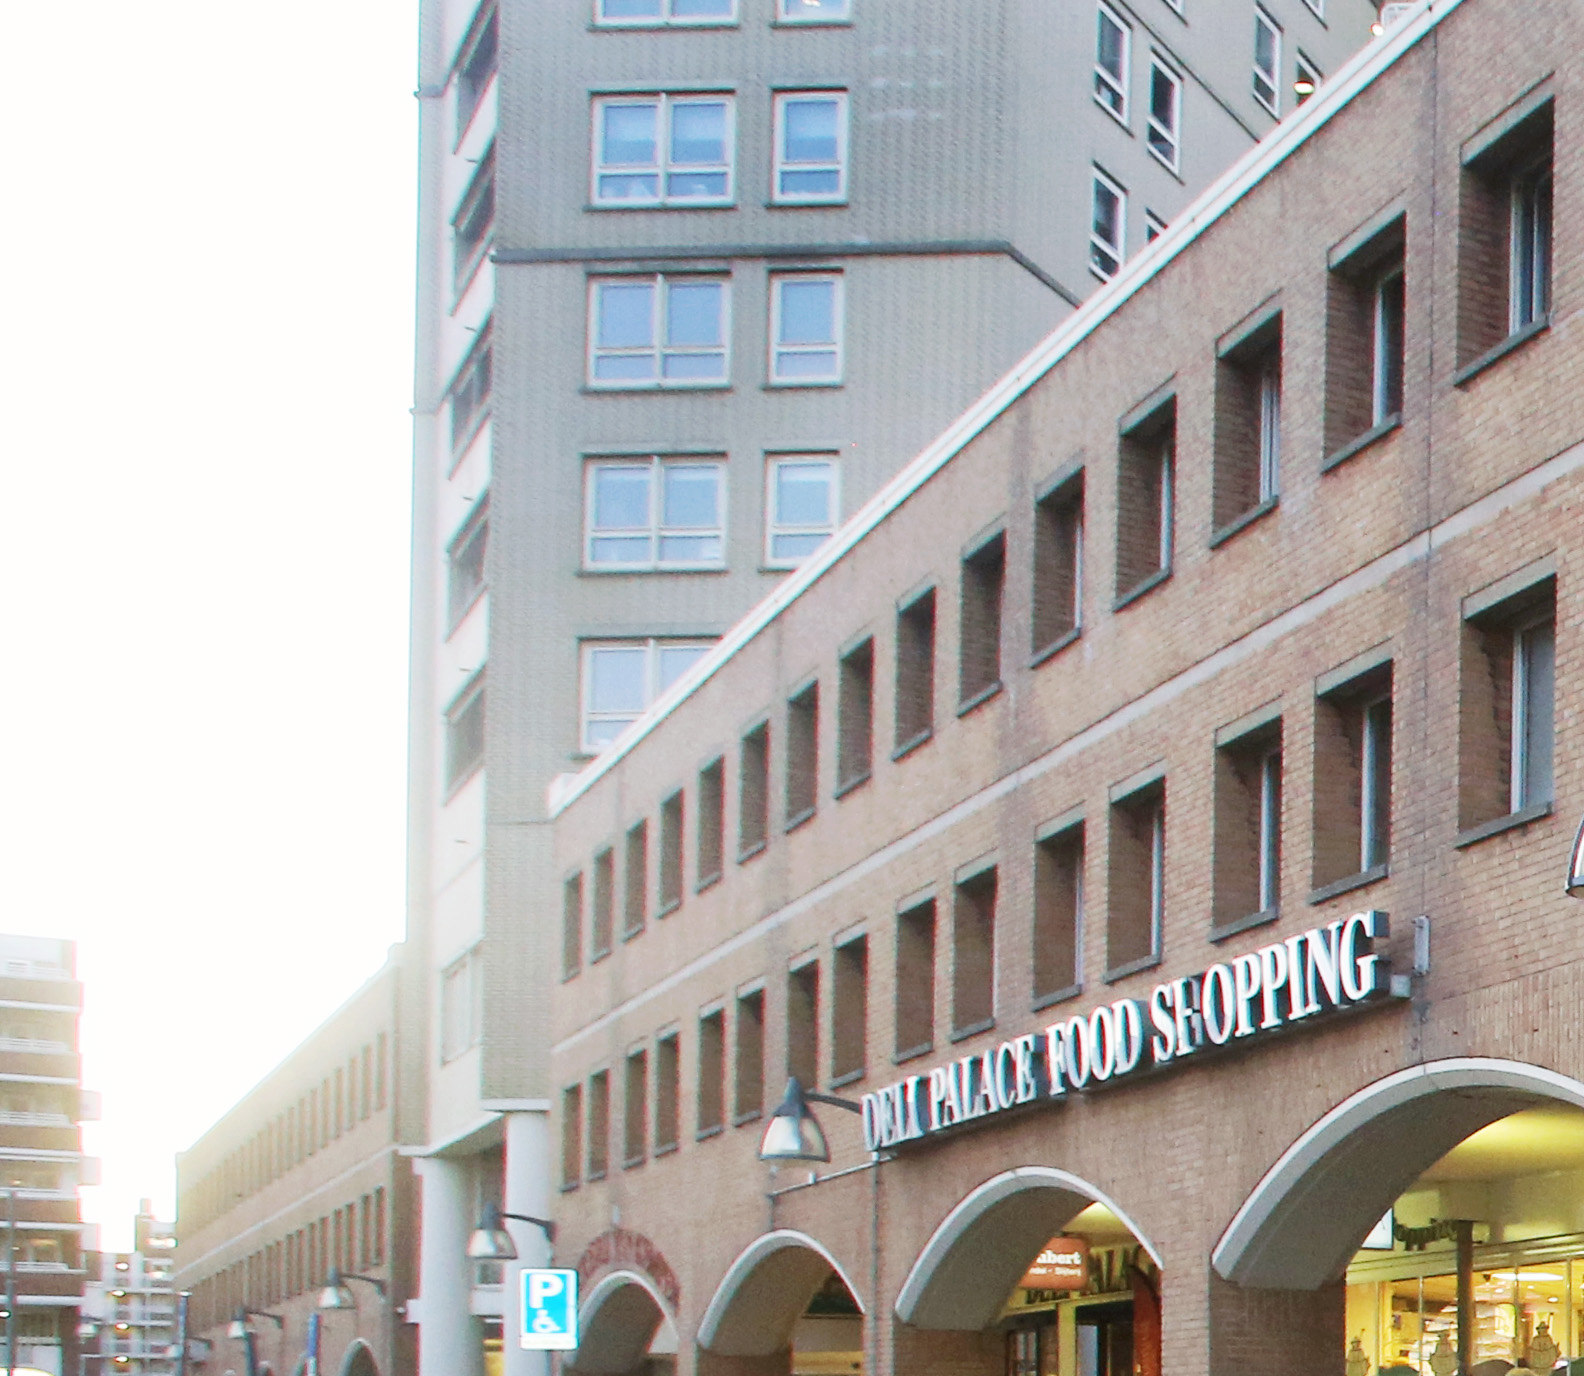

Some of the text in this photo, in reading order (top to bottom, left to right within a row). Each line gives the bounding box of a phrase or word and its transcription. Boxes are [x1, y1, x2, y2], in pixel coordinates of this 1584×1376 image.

[861, 910, 1380, 1152] DELI PALACE FOOD SHOPPING
[529, 1273, 564, 1309] P
